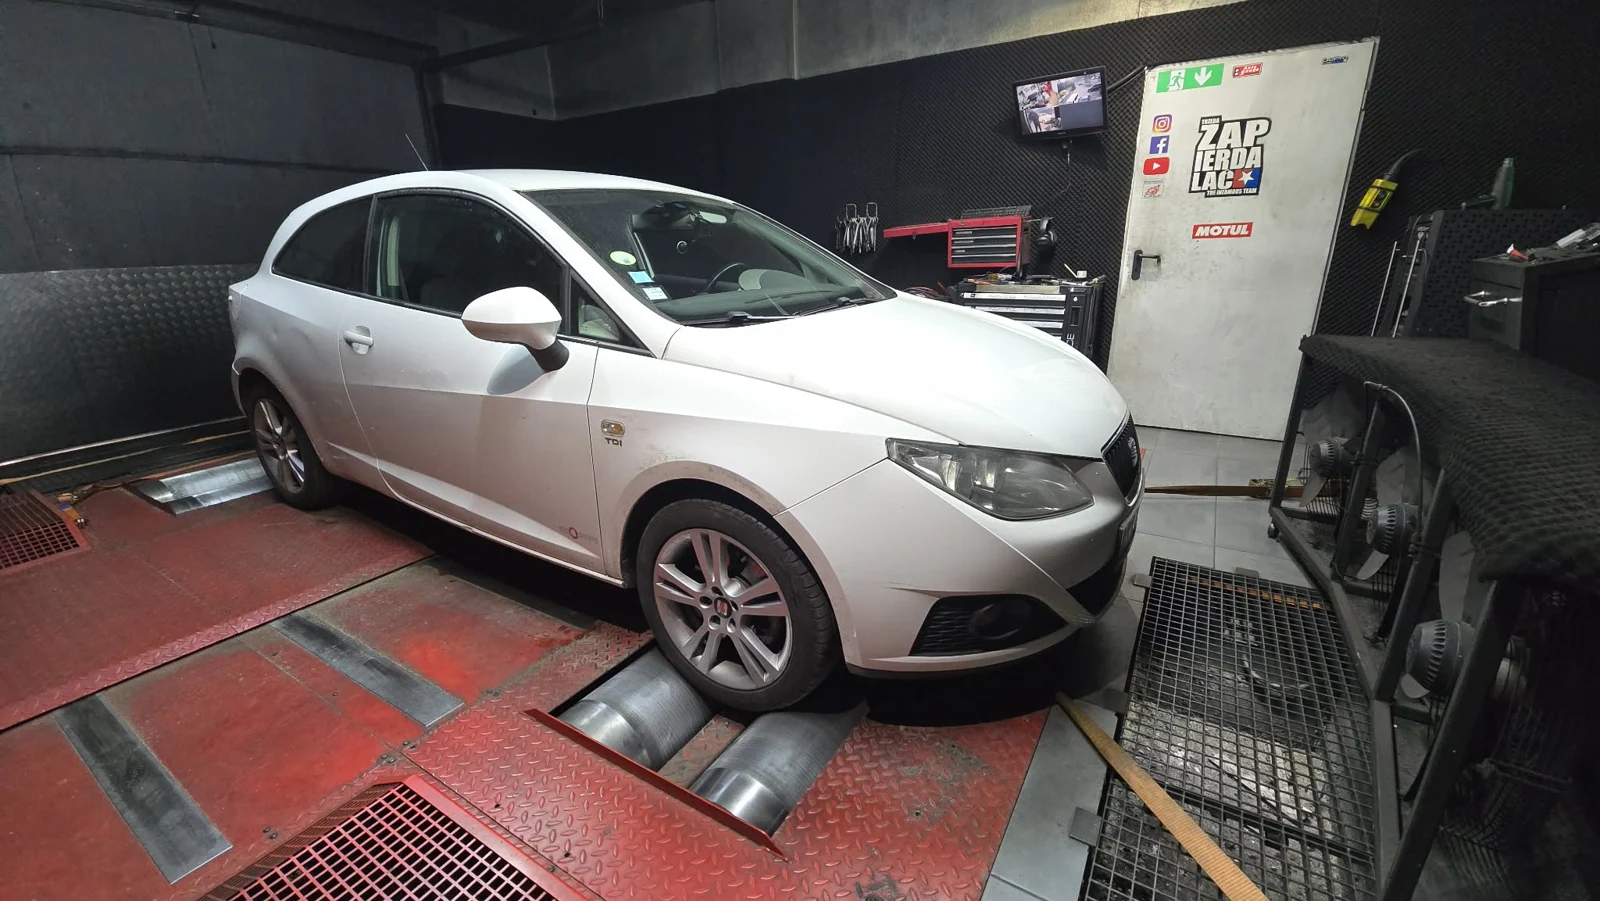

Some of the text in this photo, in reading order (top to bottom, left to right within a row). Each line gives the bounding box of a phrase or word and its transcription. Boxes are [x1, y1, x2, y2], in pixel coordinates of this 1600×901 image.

[1197, 120, 1269, 150] ZAP
[1194, 146, 1262, 172] IERDA
[1195, 225, 1248, 236] MOTUL
[604, 437, 623, 447] TDI
